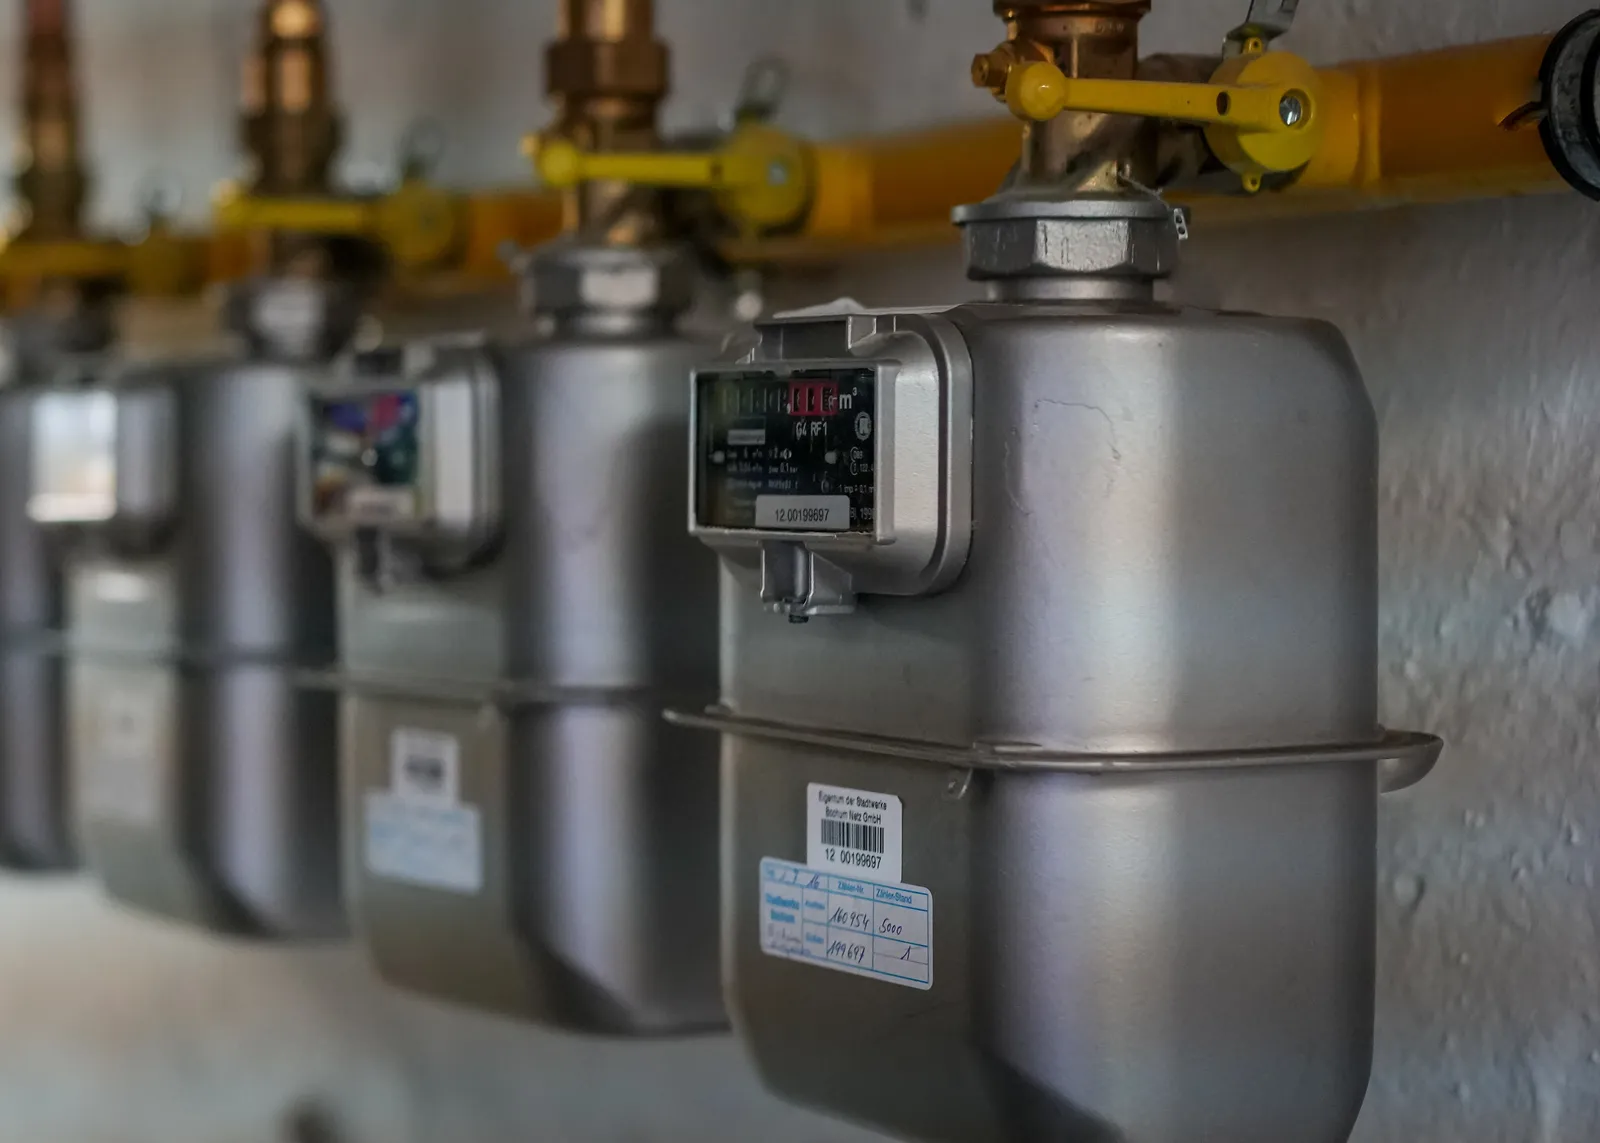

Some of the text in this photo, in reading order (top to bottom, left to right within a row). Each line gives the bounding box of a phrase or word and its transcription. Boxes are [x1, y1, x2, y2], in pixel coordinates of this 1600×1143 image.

[846, 796, 855, 806] der
[856, 796, 887, 811] Stadtwerke
[825, 806, 882, 825] Bochum Netz GmbH
[825, 847, 882, 870] 12 00199697
[876, 887, 913, 905] Zähler-Stand
[879, 918, 903, 936] 5000
